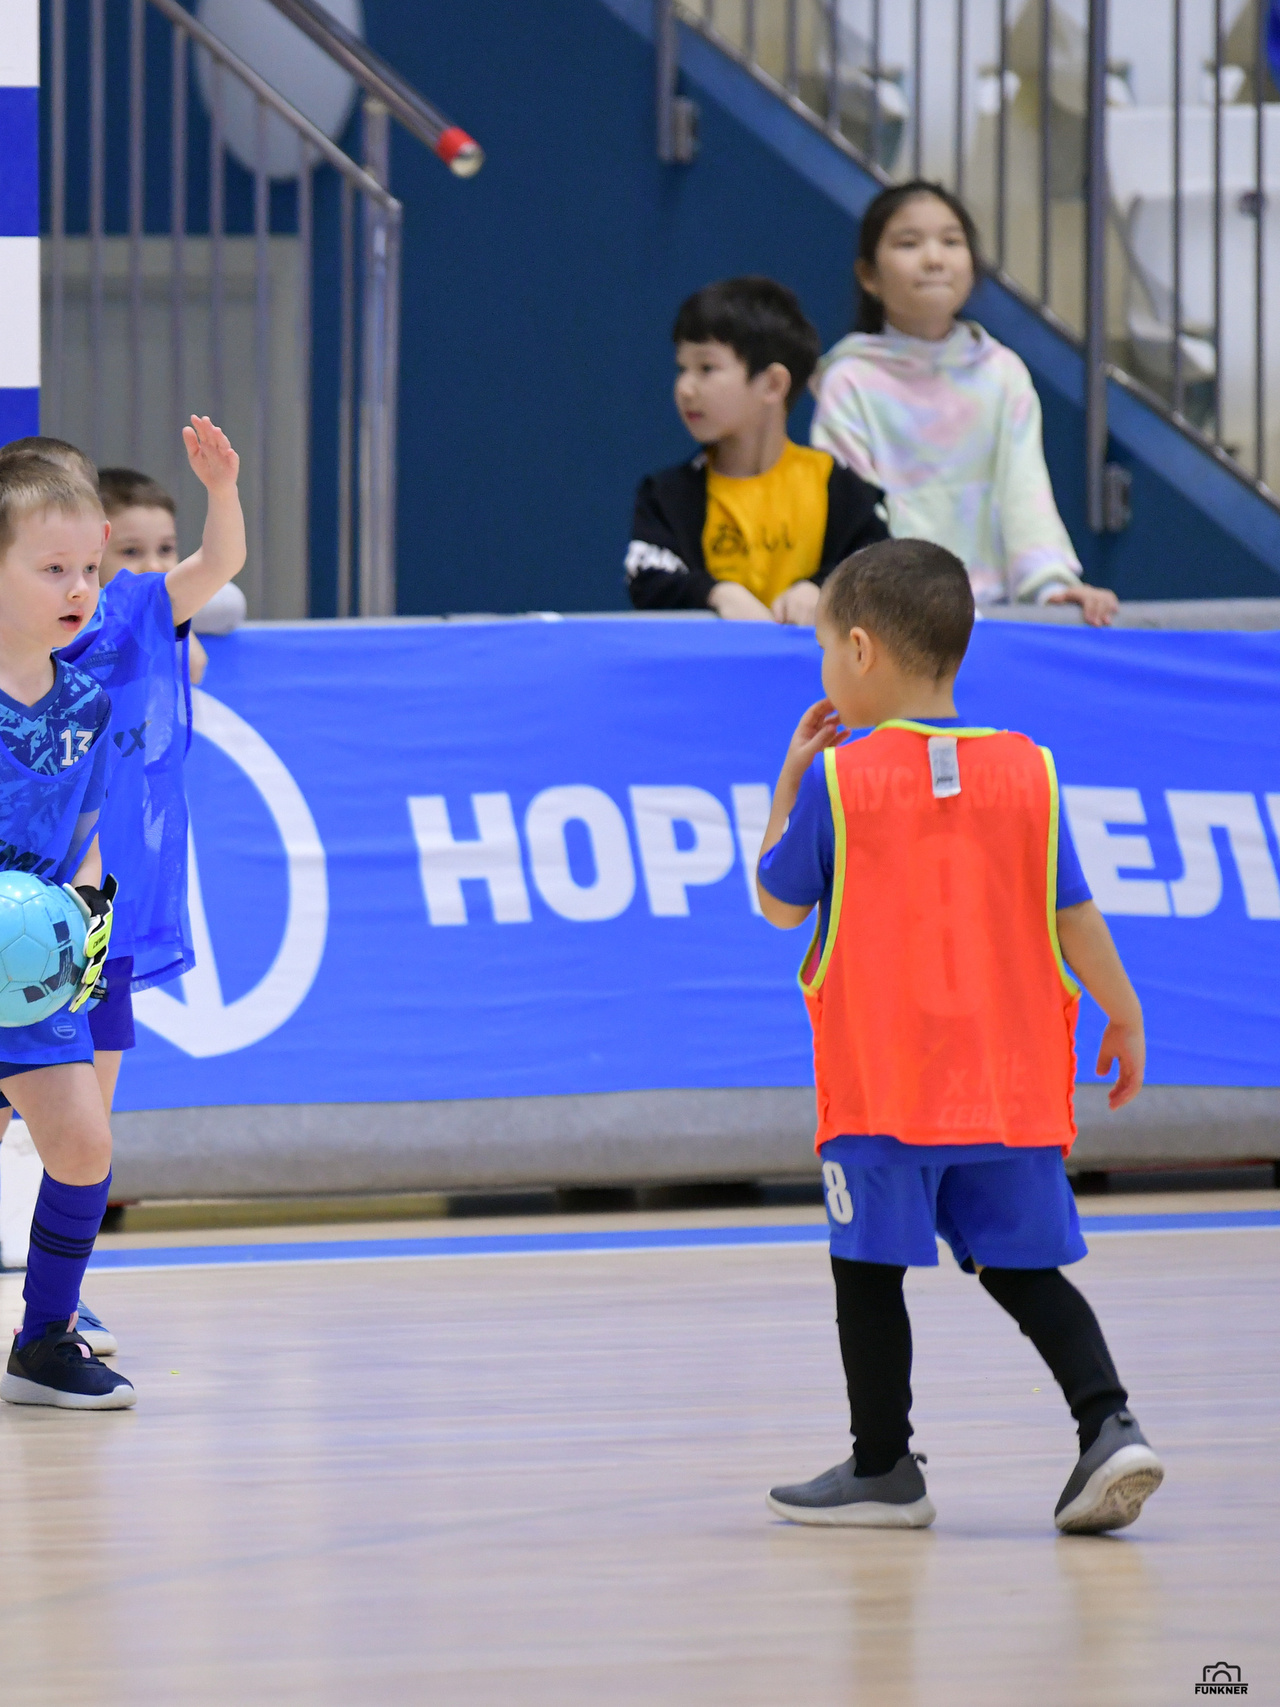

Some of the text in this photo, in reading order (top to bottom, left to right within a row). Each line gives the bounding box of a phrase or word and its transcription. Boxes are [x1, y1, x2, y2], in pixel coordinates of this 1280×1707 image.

[840, 764, 1034, 812] МУСАКИН
[909, 833, 991, 1017] 8
[822, 1160, 854, 1225] 8
